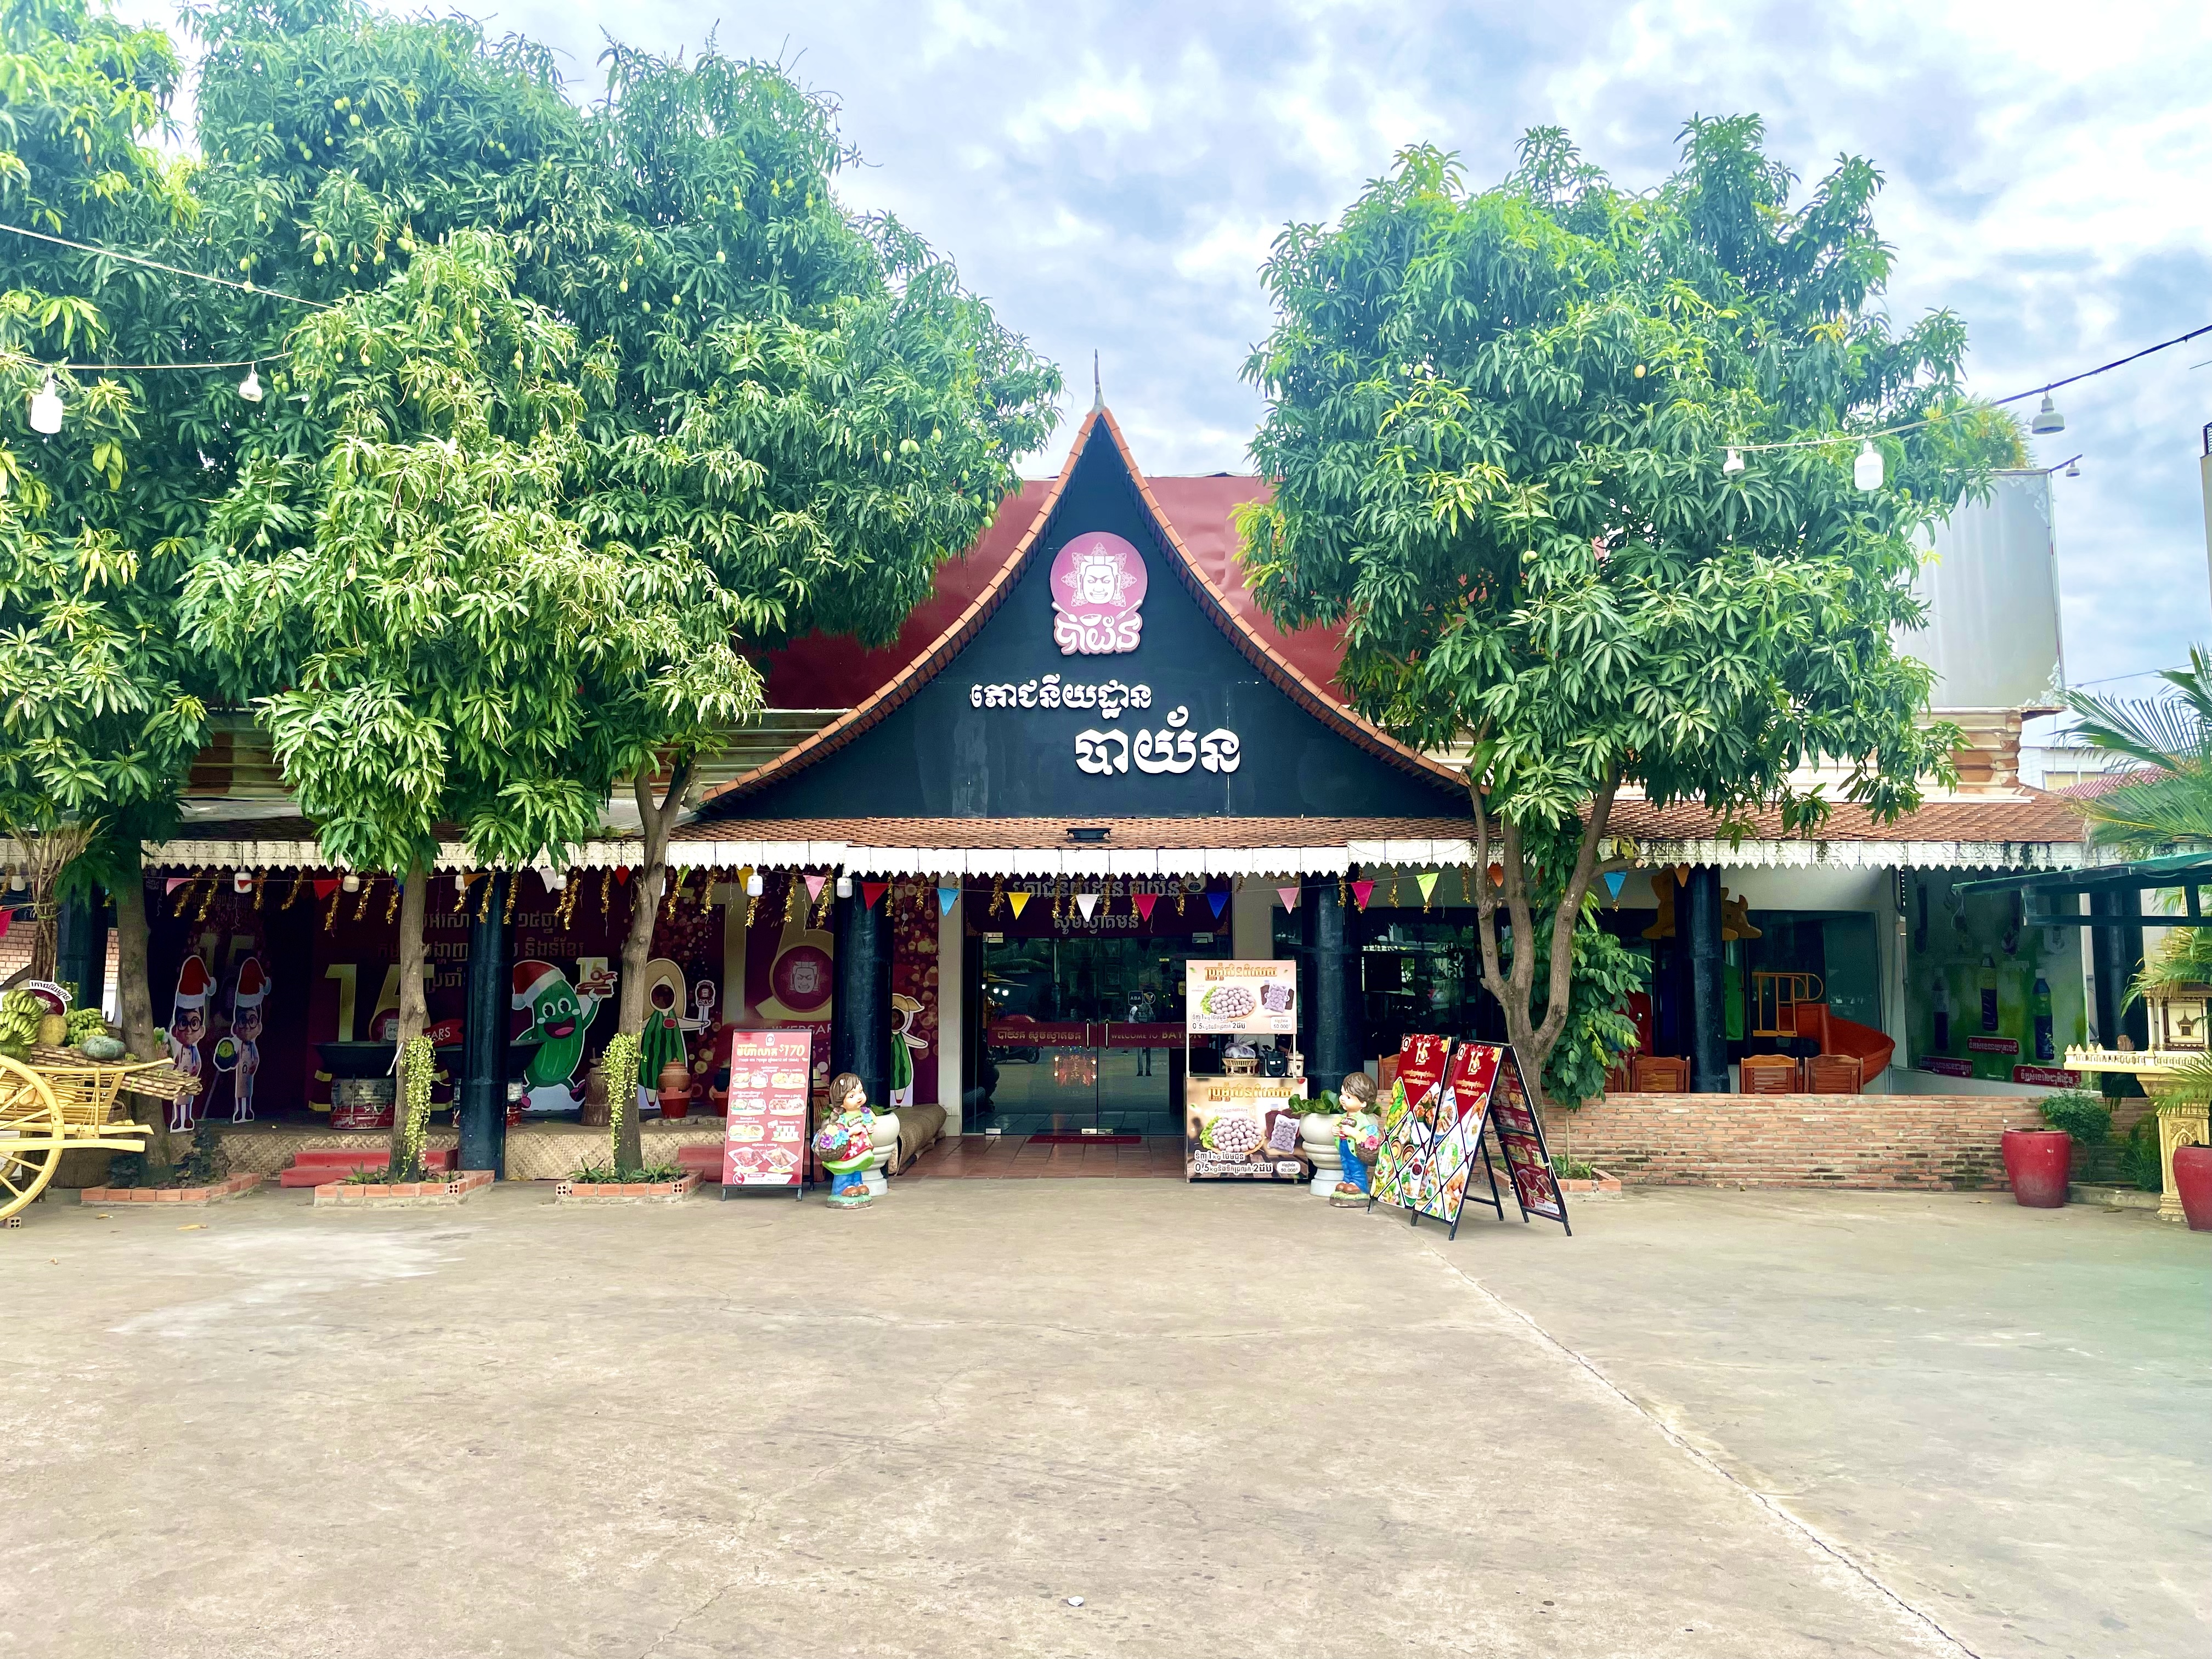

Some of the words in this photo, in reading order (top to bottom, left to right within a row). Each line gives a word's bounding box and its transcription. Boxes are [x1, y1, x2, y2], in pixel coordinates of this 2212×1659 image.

[970, 674, 1152, 719] ភោជនីយដ្ឋាន
[1075, 706, 1241, 775] បាយ័ន
[779, 1044, 805, 1057] $170
